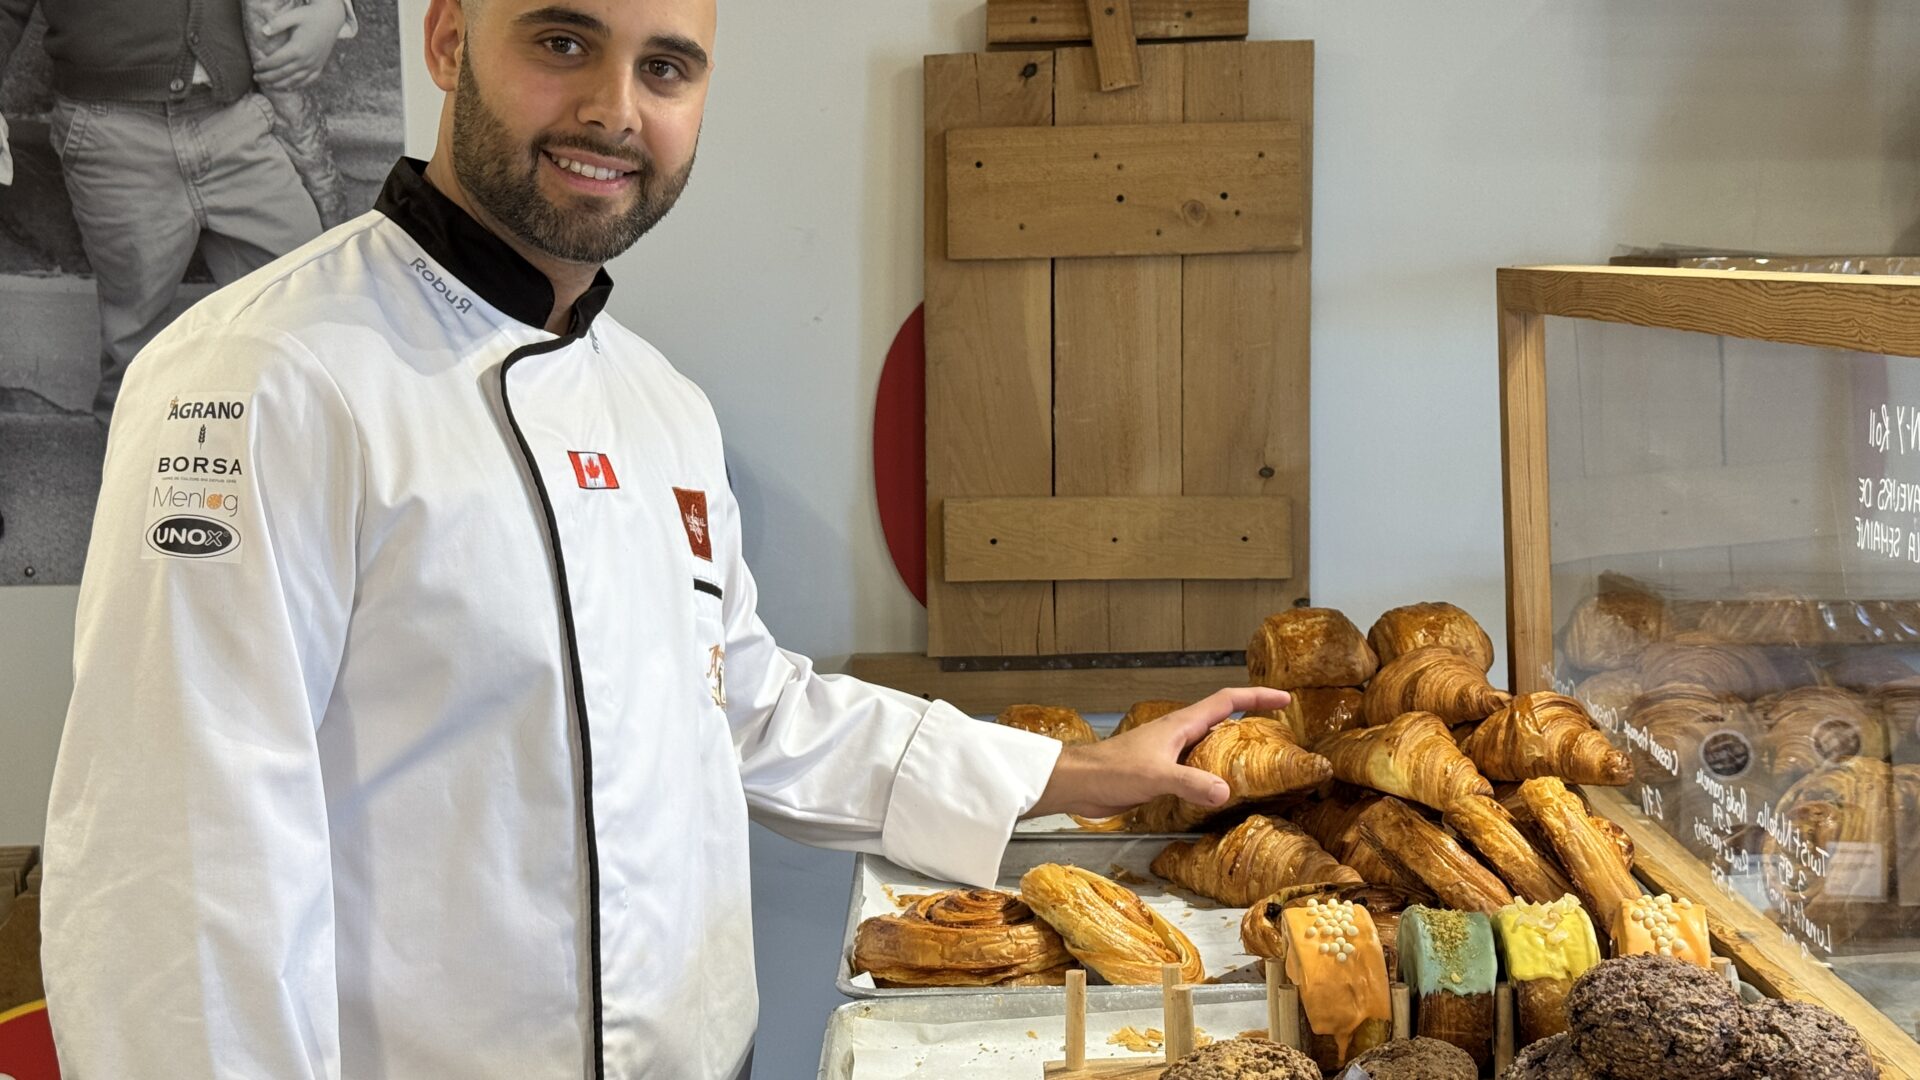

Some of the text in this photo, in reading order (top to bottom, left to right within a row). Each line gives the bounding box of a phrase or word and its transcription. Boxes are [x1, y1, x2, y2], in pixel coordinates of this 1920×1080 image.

[167, 401, 244, 421] AGRANO
[157, 456, 242, 475] BORSA
[156, 527, 223, 547] UNOX
